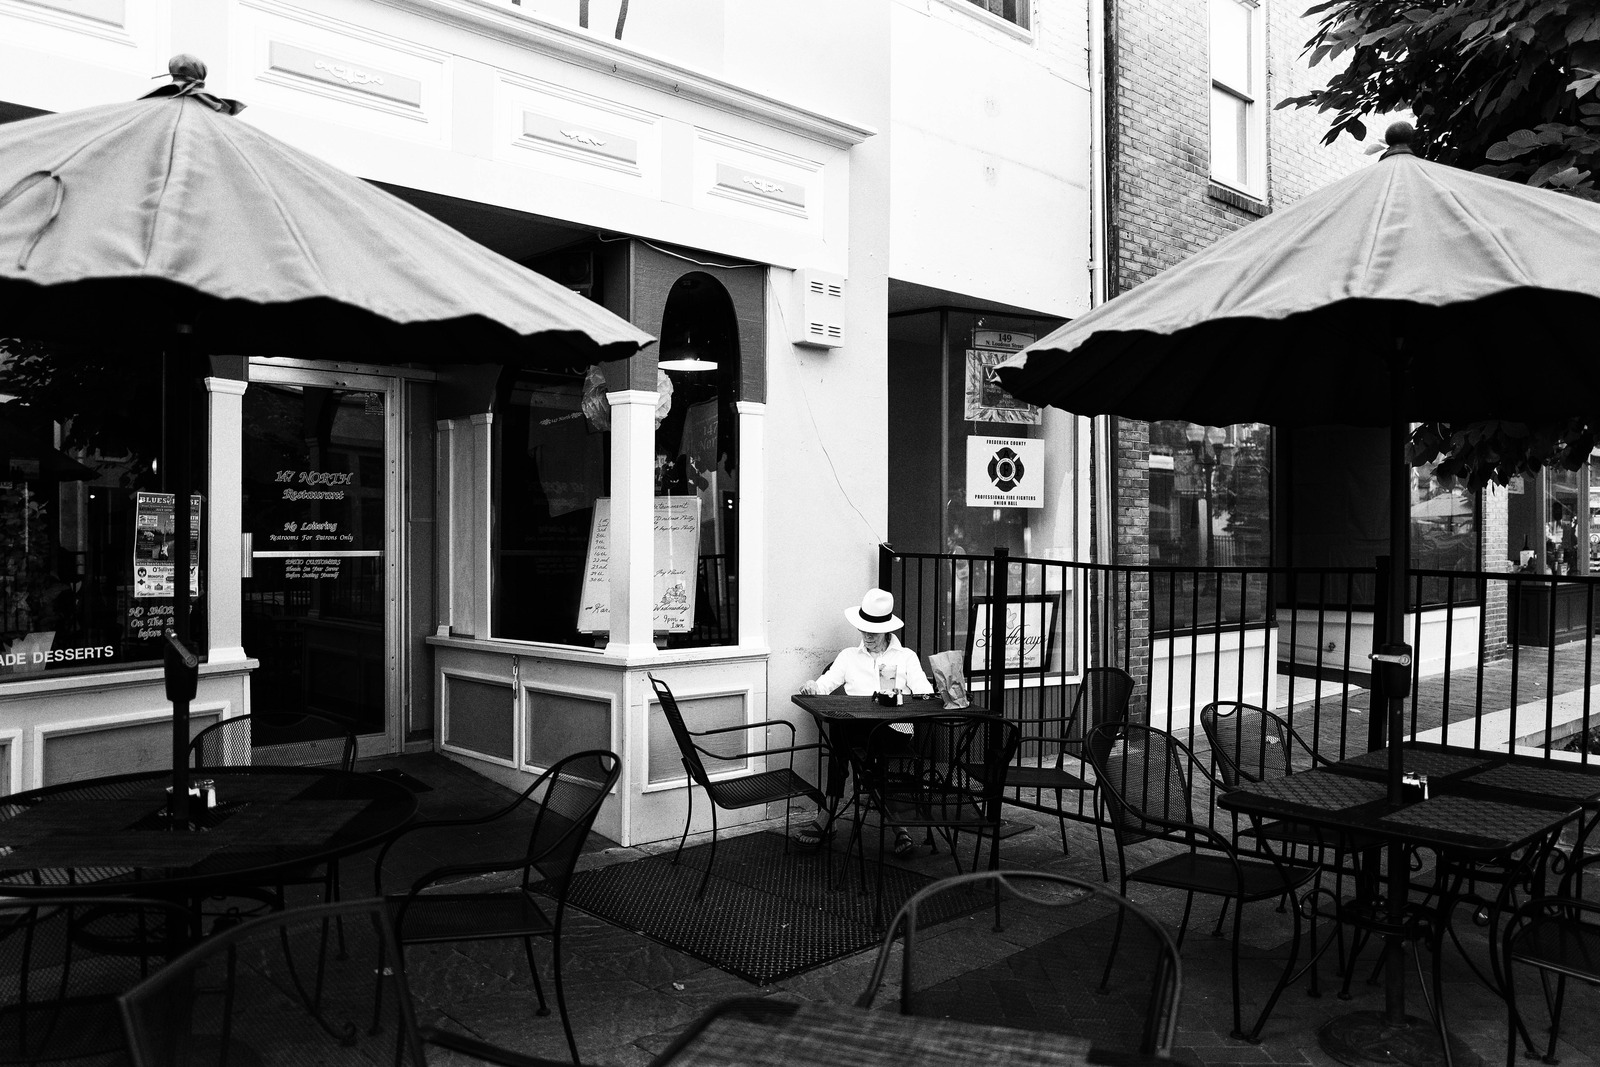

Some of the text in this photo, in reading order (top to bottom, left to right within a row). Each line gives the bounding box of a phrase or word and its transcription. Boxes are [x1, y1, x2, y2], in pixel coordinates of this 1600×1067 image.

[999, 333, 1012, 342] 149
[275, 470, 354, 486] 147 NORTH
[282, 488, 344, 501] Restaurant
[284, 521, 338, 532] No Loitering
[340, 533, 354, 542] Only
[128, 606, 144, 617] NO
[131, 619, 144, 628] On
[147, 616, 163, 627] The
[138, 628, 161, 640] before
[33, 645, 114, 664] DESSERTS
